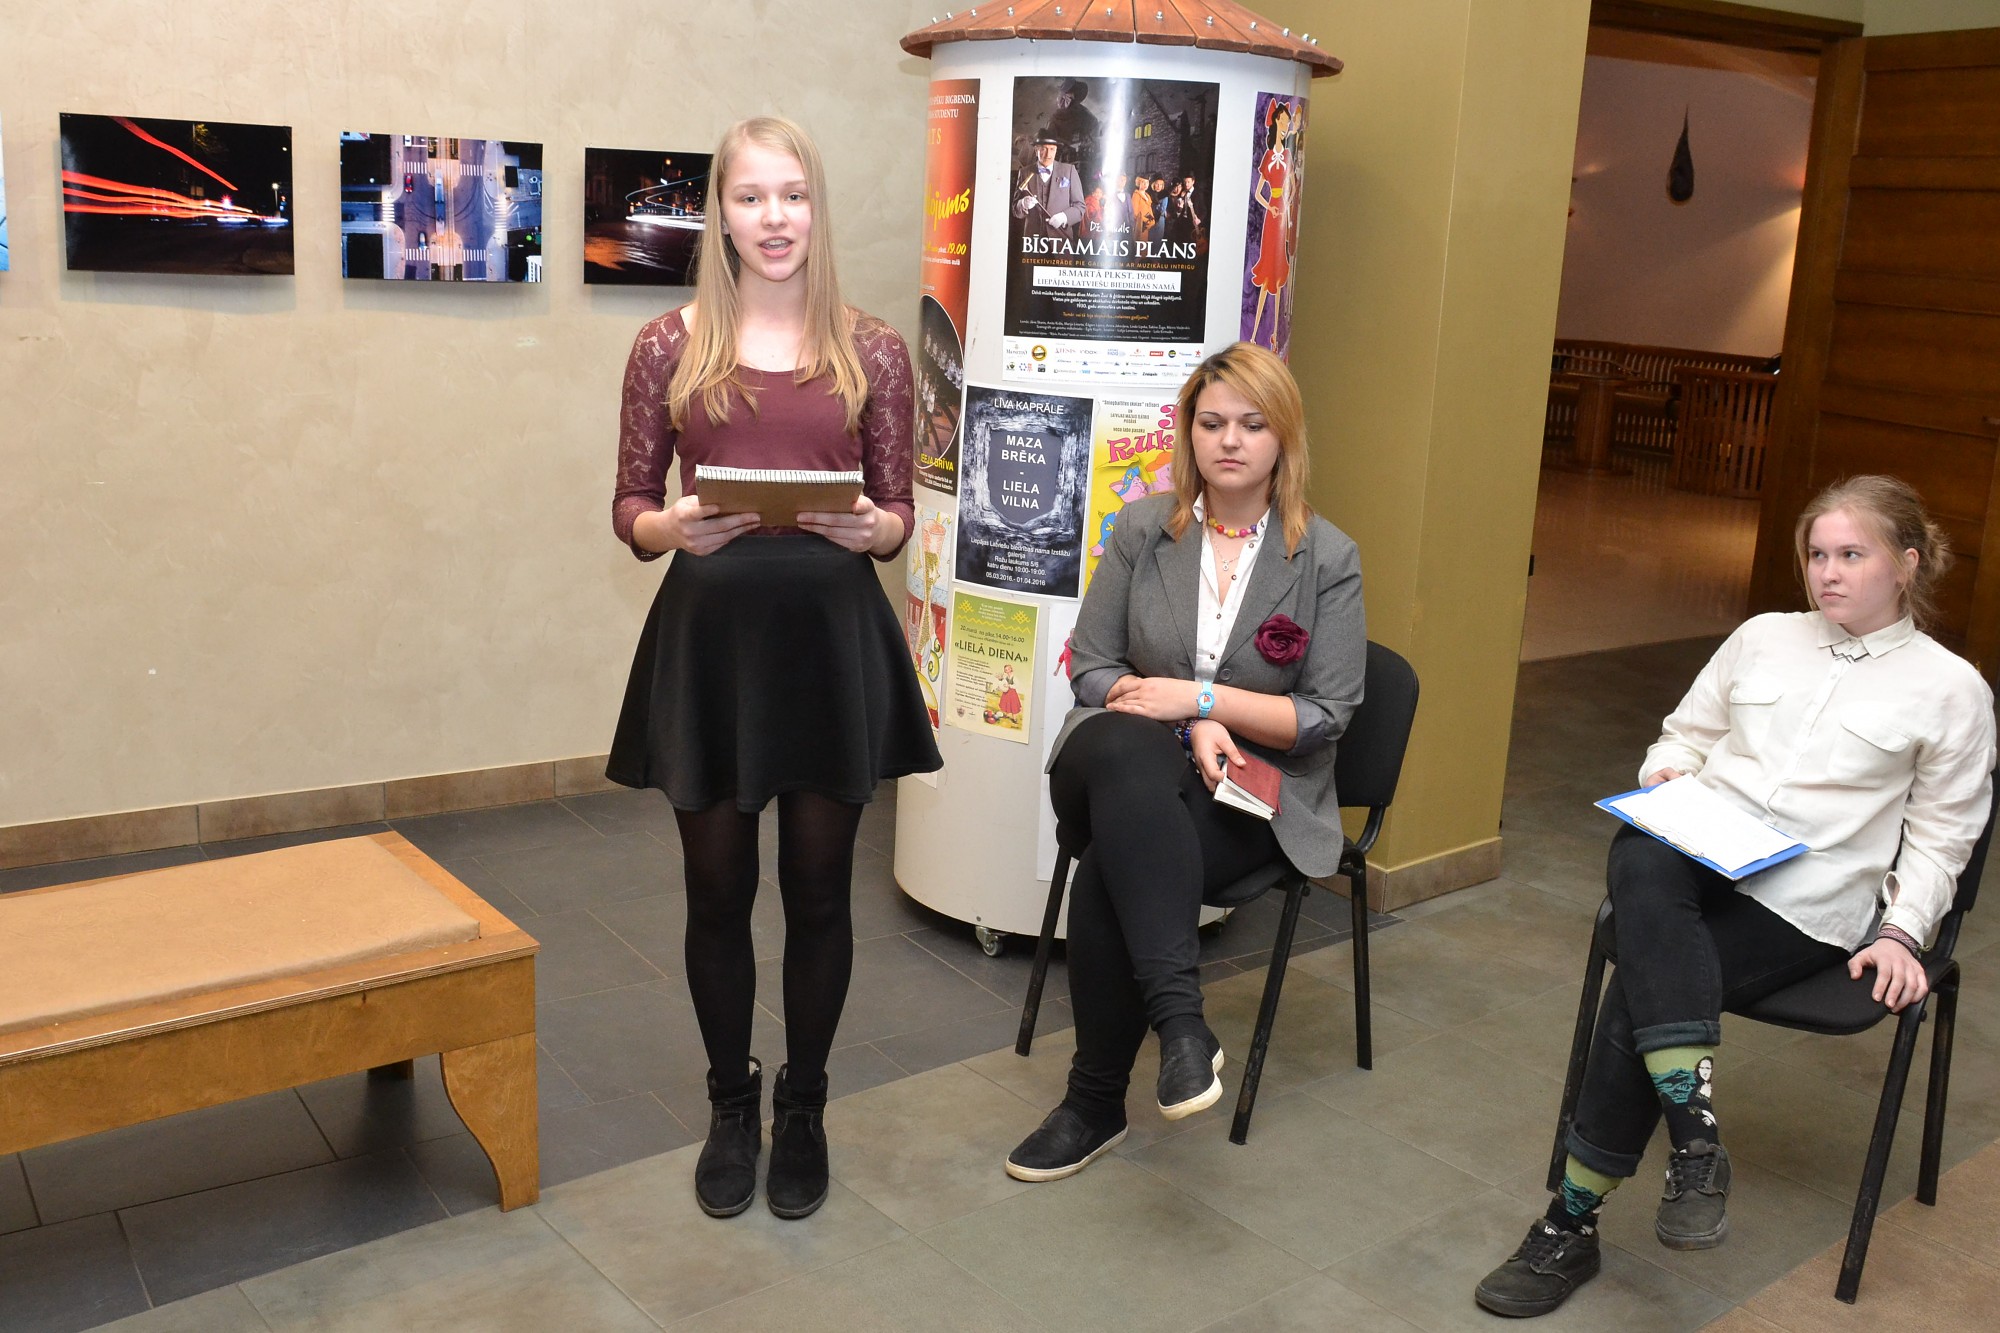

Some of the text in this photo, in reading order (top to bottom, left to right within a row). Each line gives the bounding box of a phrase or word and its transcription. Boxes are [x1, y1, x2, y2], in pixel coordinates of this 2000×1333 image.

[946, 94, 976, 104] BIGBENDA
[948, 242, 967, 255] 19.00
[1022, 234, 1197, 260] BĪSTAMAIS PLĀNS
[1021, 258, 1073, 266] DETEKTĪVIZRĀDE
[1037, 278, 1070, 286] LIEPĀJAS
[1072, 279, 1109, 287] LATVIEŠU
[1104, 271, 1135, 280] PLKST.
[994, 397, 1064, 415] LĪVA KAPRĀLE
[1006, 435, 1043, 449] MAZA
[1107, 430, 1175, 464] Ruk
[934, 457, 954, 472] BRĪVA
[1001, 450, 1046, 465] BRĒKA
[1003, 480, 1040, 495] LIELA
[1001, 495, 1040, 510] VILNA
[970, 537, 989, 548] Liepājas
[1035, 547, 1050, 555] nama
[994, 555, 1008, 563] Rožu
[1000, 563, 1014, 571] dienu
